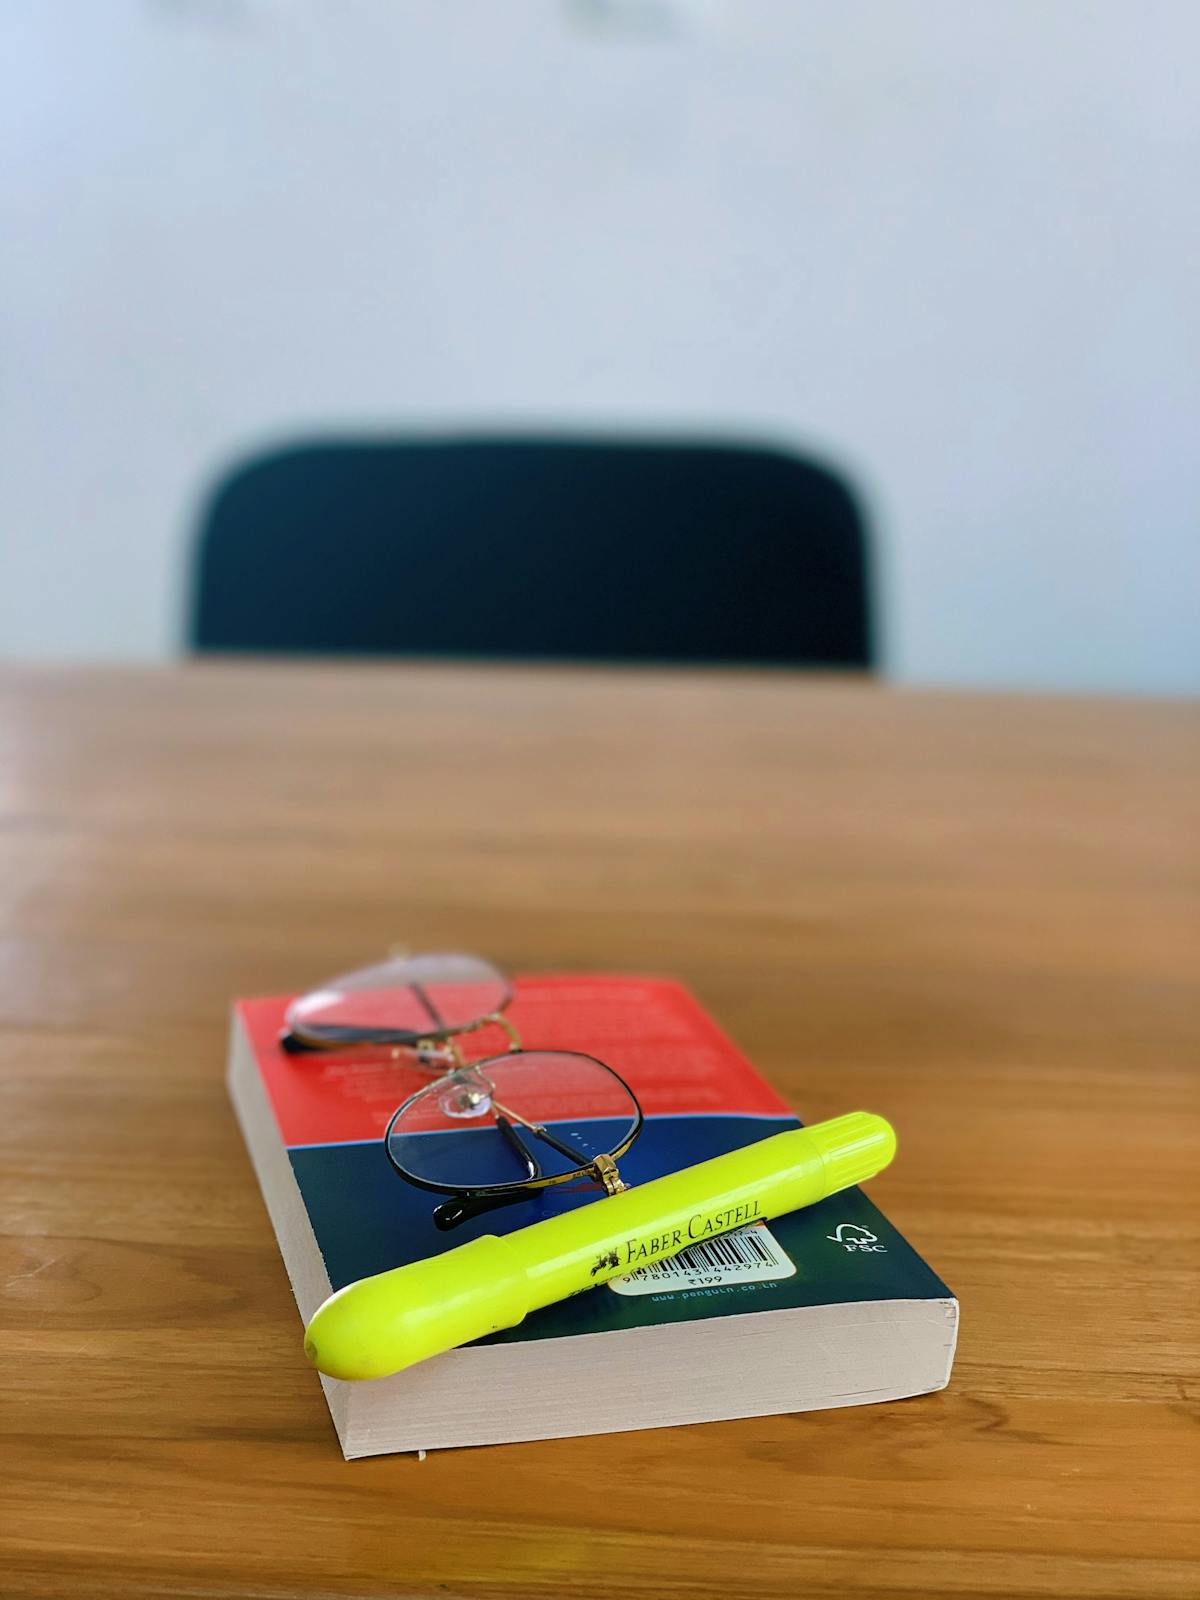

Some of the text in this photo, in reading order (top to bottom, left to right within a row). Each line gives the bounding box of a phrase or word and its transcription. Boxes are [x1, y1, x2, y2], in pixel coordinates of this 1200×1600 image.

[624, 1200, 761, 1264] FABER-CASTELL
[843, 1244, 888, 1253] FSC
[688, 1275, 722, 1286] ₹199
[651, 1282, 778, 1302] www.penguin.co.in
